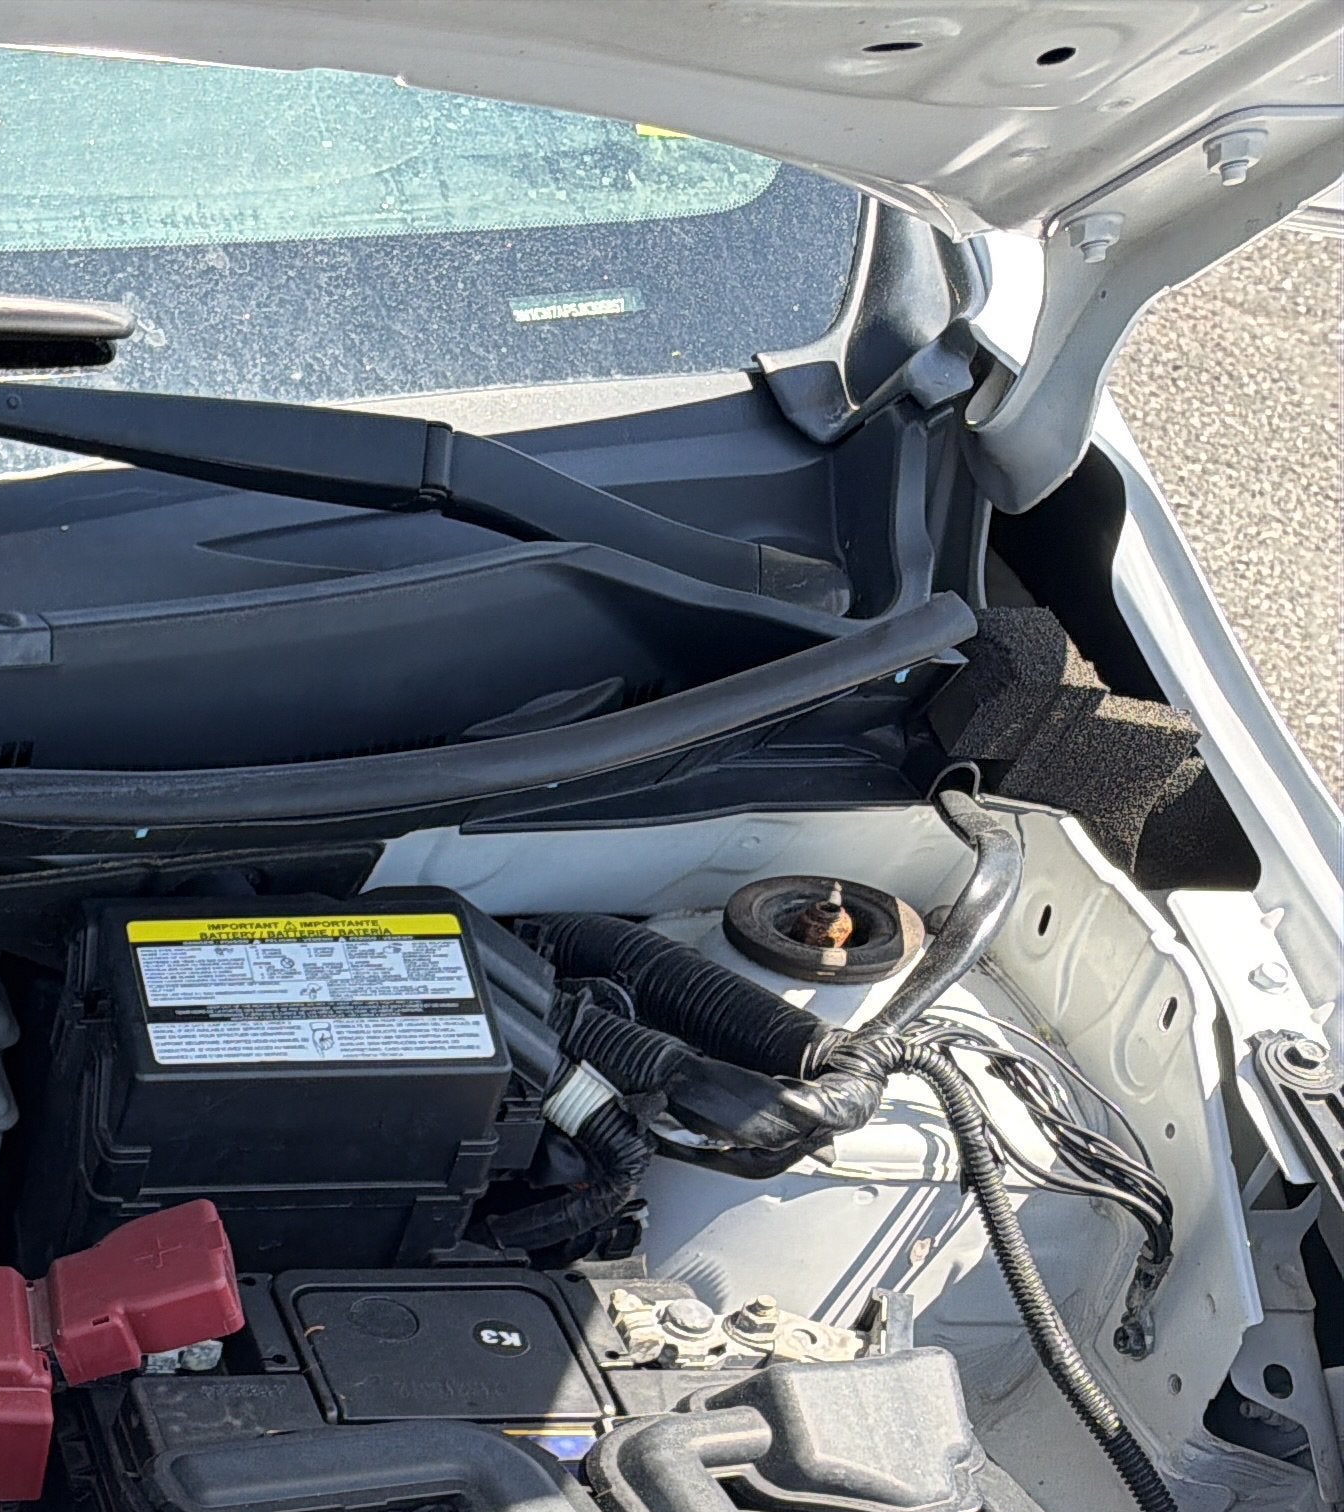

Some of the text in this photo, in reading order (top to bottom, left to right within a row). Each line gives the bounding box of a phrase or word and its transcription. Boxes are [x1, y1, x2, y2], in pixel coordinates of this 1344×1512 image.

[207, 919, 379, 931] IMPORTANT IMPORTANTE
[199, 931, 256, 941] BATTERY
[267, 929, 328, 939] BATTERIE
[480, 1329, 522, 1347] K3
